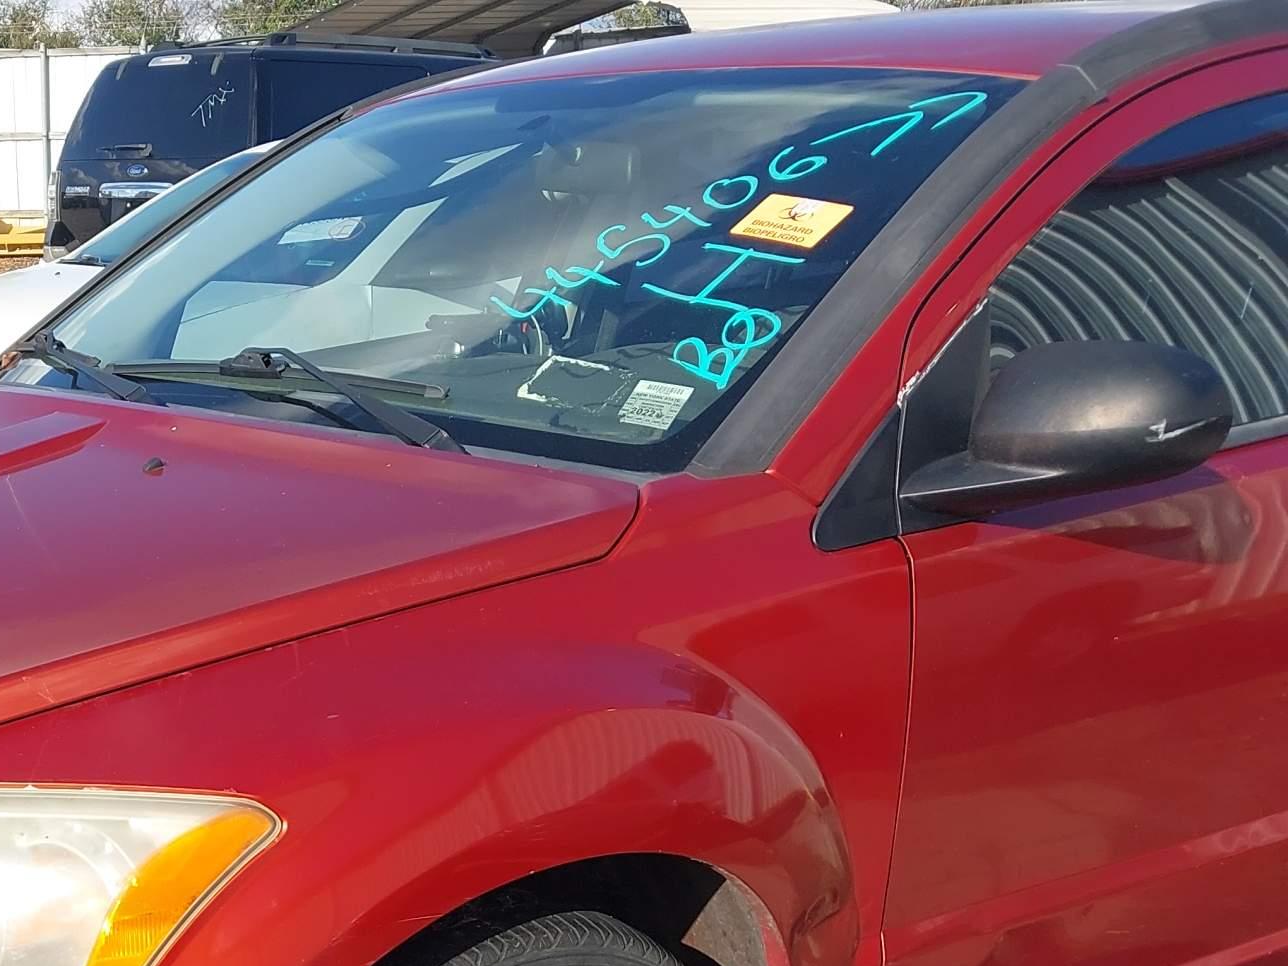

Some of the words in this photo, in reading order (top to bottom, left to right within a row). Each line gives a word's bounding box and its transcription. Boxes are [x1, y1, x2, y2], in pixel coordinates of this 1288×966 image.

[490, 91, 988, 319] 44540677
[743, 227, 805, 243] BIOPELIGRO
[752, 219, 814, 235] BIOHAZARD
